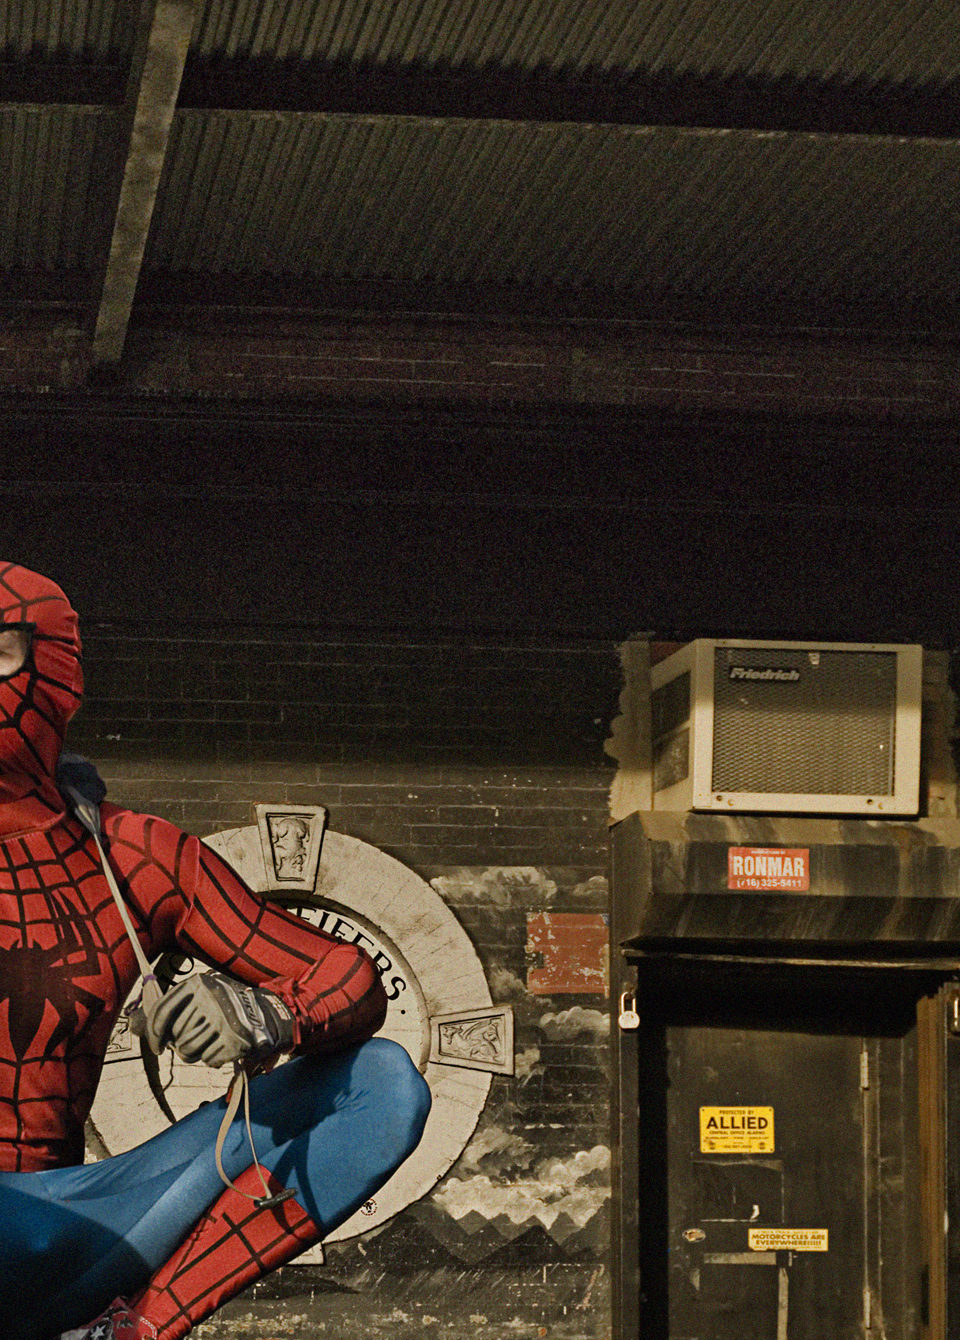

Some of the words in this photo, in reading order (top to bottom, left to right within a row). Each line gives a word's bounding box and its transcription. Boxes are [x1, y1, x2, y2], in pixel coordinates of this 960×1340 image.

[730, 667, 800, 681] Friedrich
[733, 855, 805, 877] RONMAR
[706, 1116, 768, 1129] ALLIED
